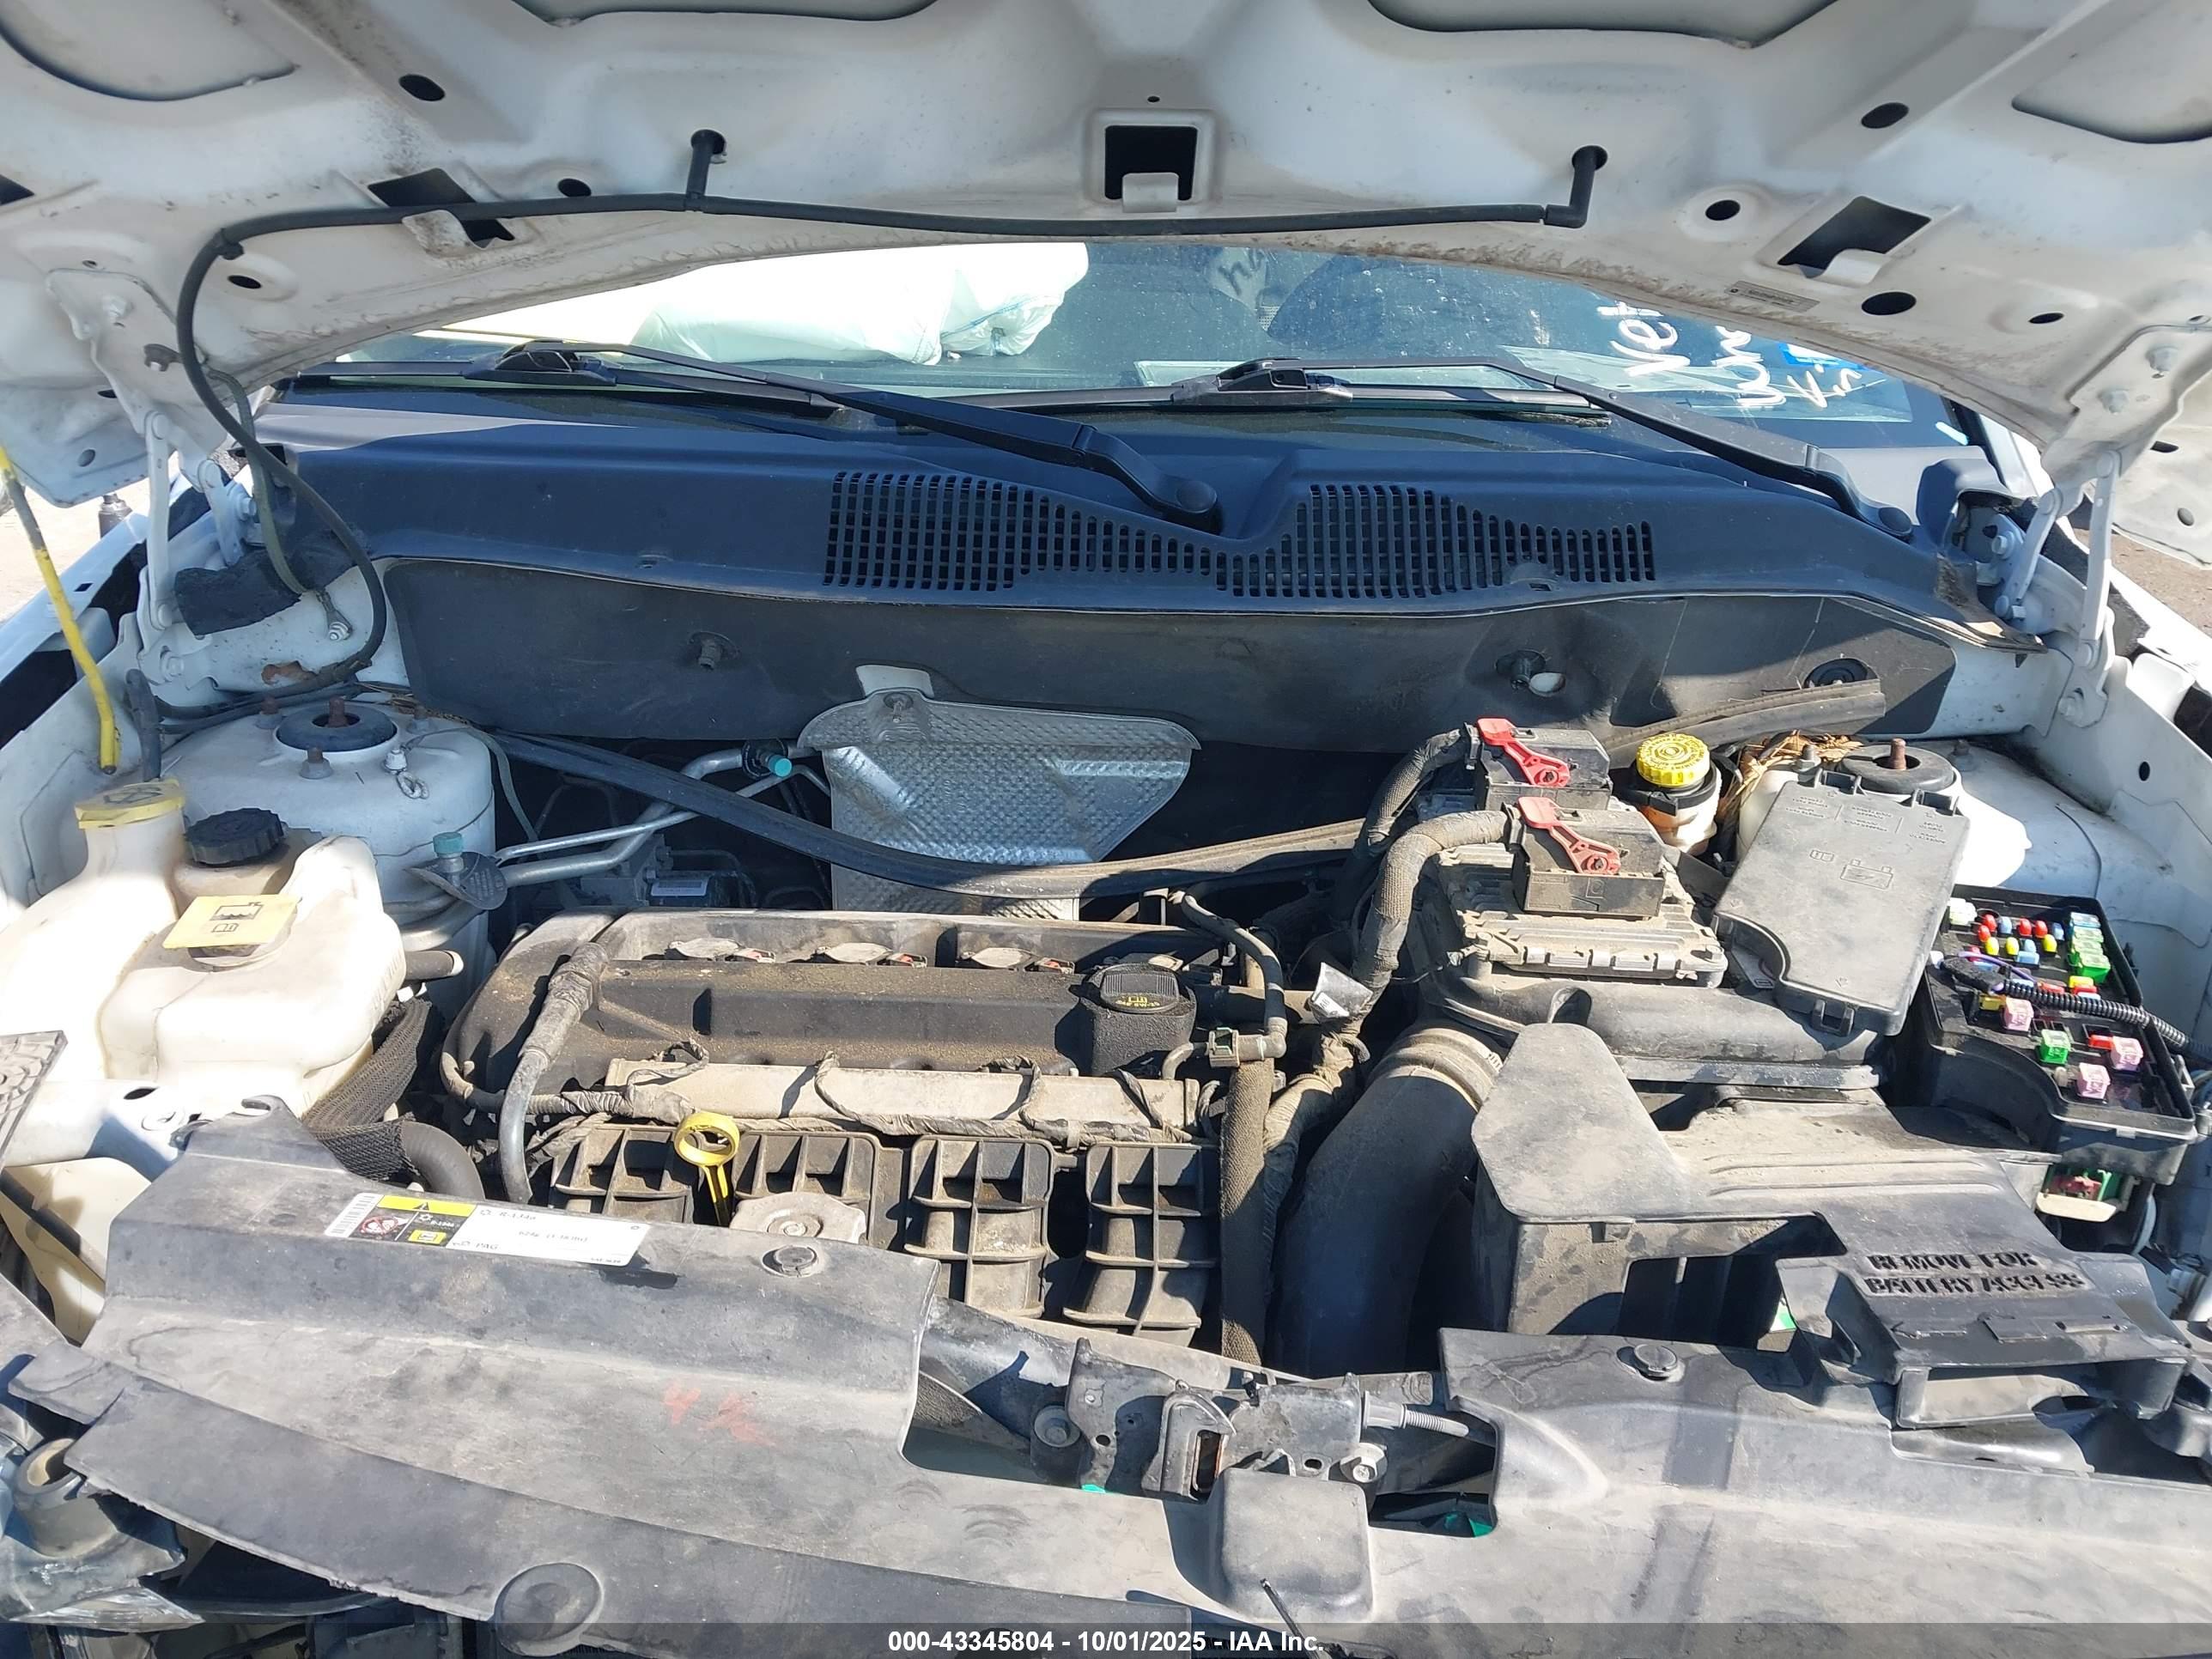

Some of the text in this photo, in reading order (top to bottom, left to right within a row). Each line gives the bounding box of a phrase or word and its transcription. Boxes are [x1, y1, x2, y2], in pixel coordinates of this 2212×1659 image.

[1866, 1252, 2041, 1271] REMOVE FOR
[1863, 1273, 2086, 1296] BATTERY ACCESS
